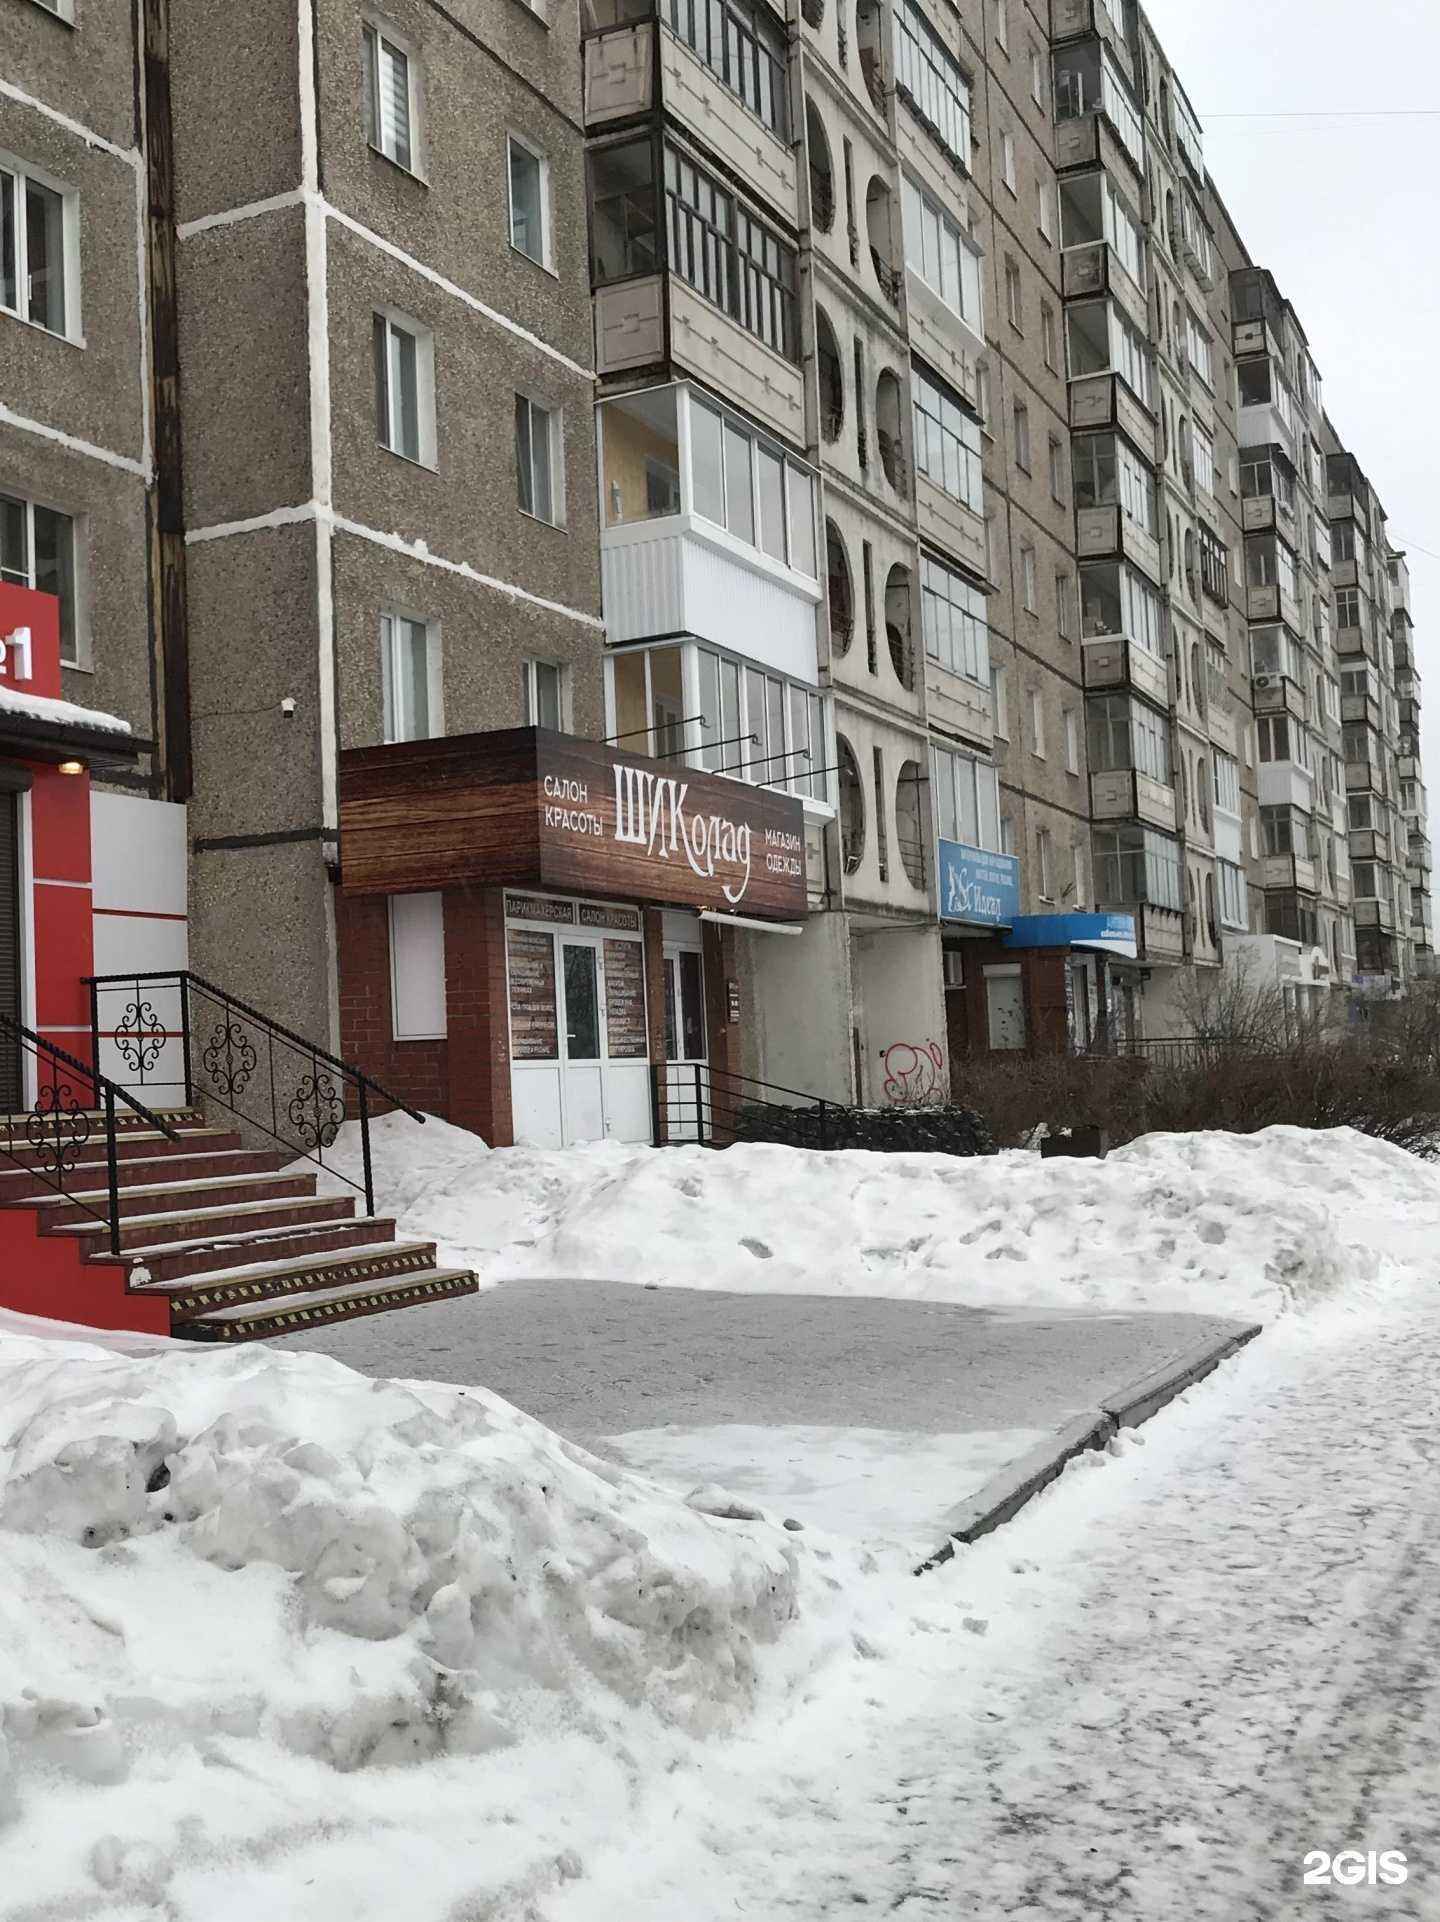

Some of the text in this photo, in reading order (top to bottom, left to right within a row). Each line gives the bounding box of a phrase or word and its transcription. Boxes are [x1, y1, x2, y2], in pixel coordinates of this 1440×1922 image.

[0, 626, 32, 680] 1
[544, 775, 588, 803] САЛОН
[544, 805, 604, 837] КРАСОТЫ
[764, 828, 801, 851] МАГАЗИН
[766, 856, 802, 876] ОДЕЖДЫ
